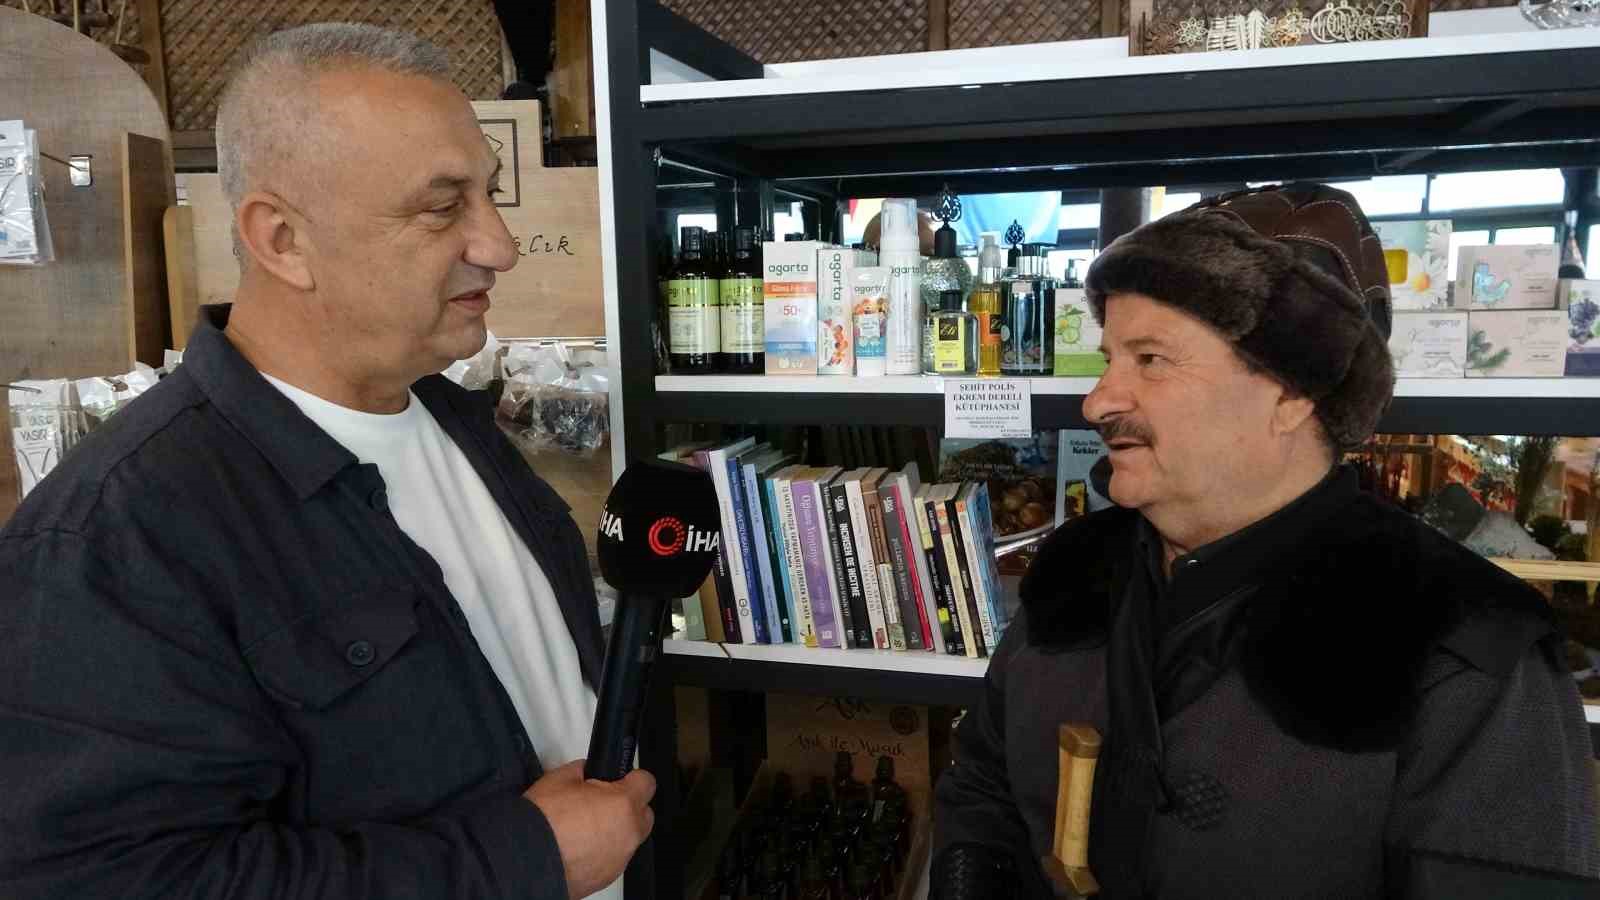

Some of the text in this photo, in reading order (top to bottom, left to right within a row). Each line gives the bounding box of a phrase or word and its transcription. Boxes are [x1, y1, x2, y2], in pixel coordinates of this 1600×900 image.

[768, 264, 809, 276] agarta
[829, 253, 843, 301] agarta
[989, 383, 1016, 391] POLİS
[953, 393, 986, 401] EKREM
[685, 525, 720, 552] İHA
